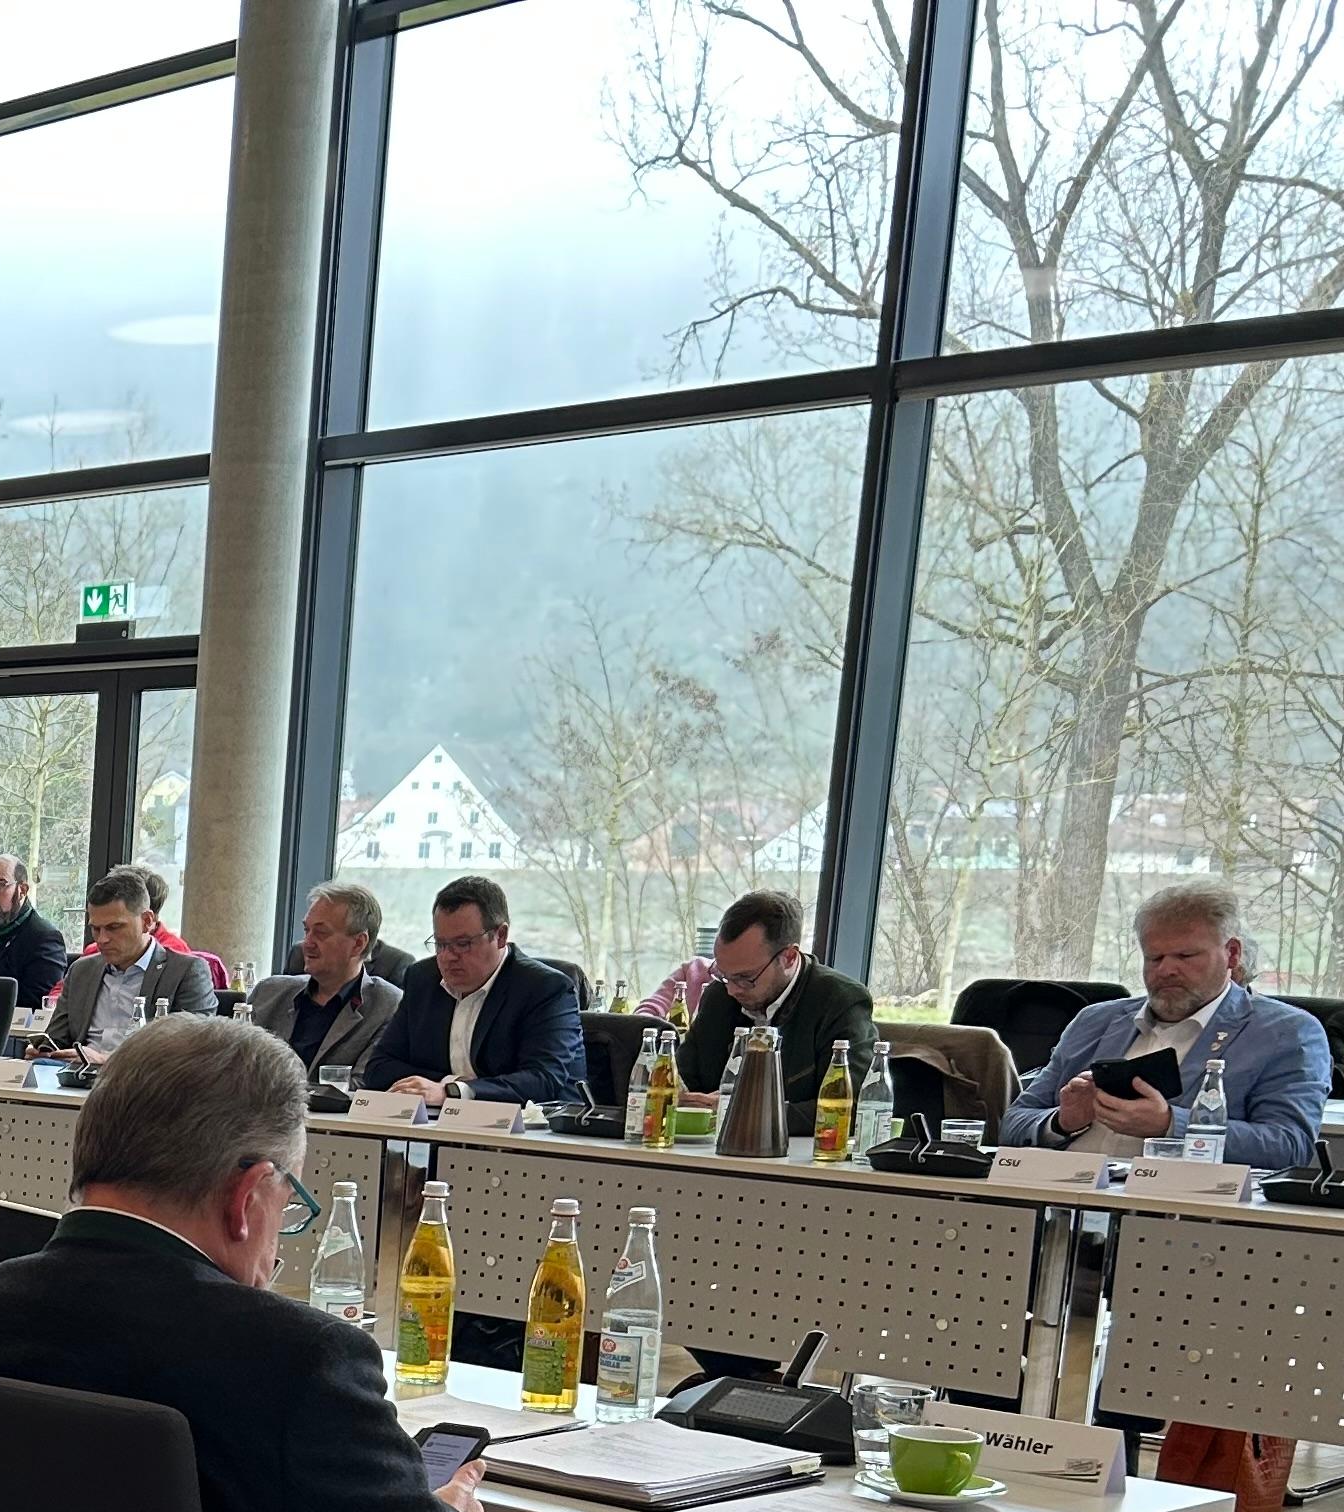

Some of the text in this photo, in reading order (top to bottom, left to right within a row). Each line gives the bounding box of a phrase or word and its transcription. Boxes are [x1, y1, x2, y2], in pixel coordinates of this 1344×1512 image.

[444, 1107, 460, 1115] CSU
[998, 1158, 1021, 1167] CSU
[1134, 1168, 1158, 1178] CSU
[985, 1431, 1054, 1455] Wähler
